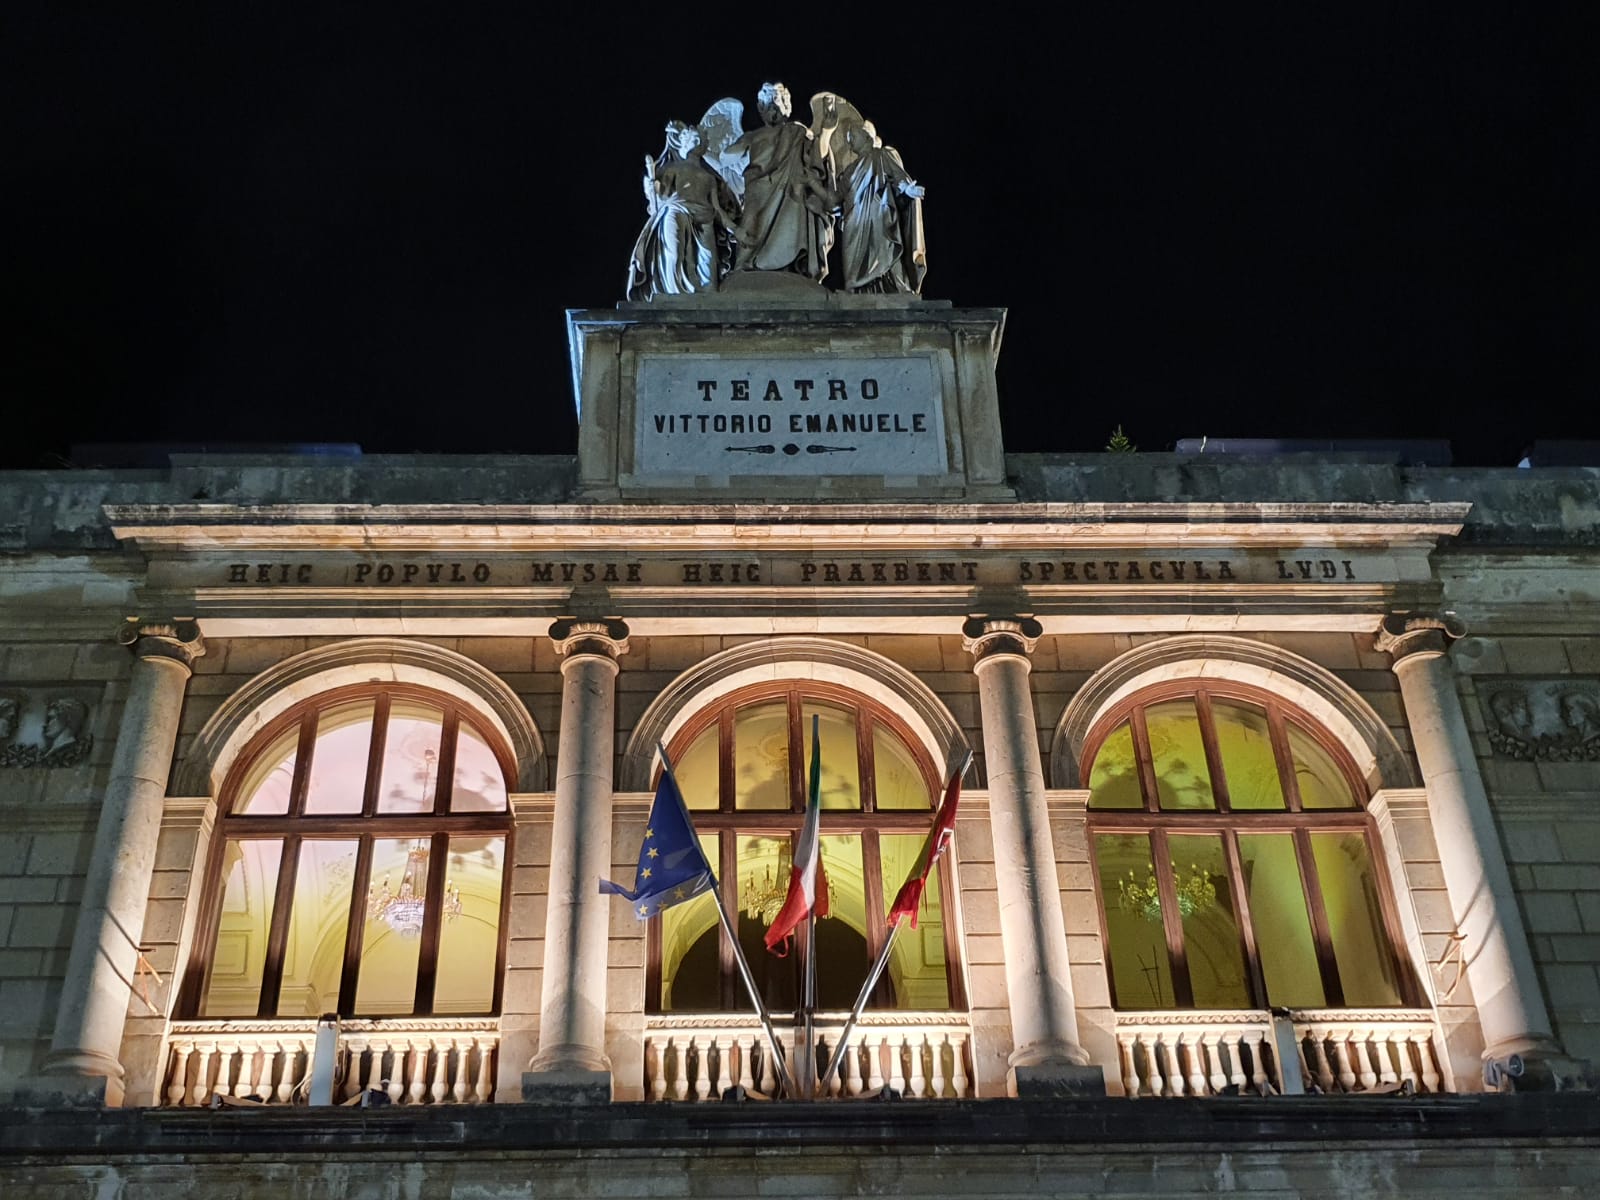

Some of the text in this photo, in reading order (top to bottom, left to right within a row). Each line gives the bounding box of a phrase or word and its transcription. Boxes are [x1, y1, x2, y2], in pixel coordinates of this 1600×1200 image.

[697, 378, 880, 402] TEATRO
[653, 413, 928, 434] VITTORIO EMANUELE
[227, 559, 1357, 584] HEIC POPVLO MVSAE HEIC PRAEBENT SPECTACVLA LVDI
